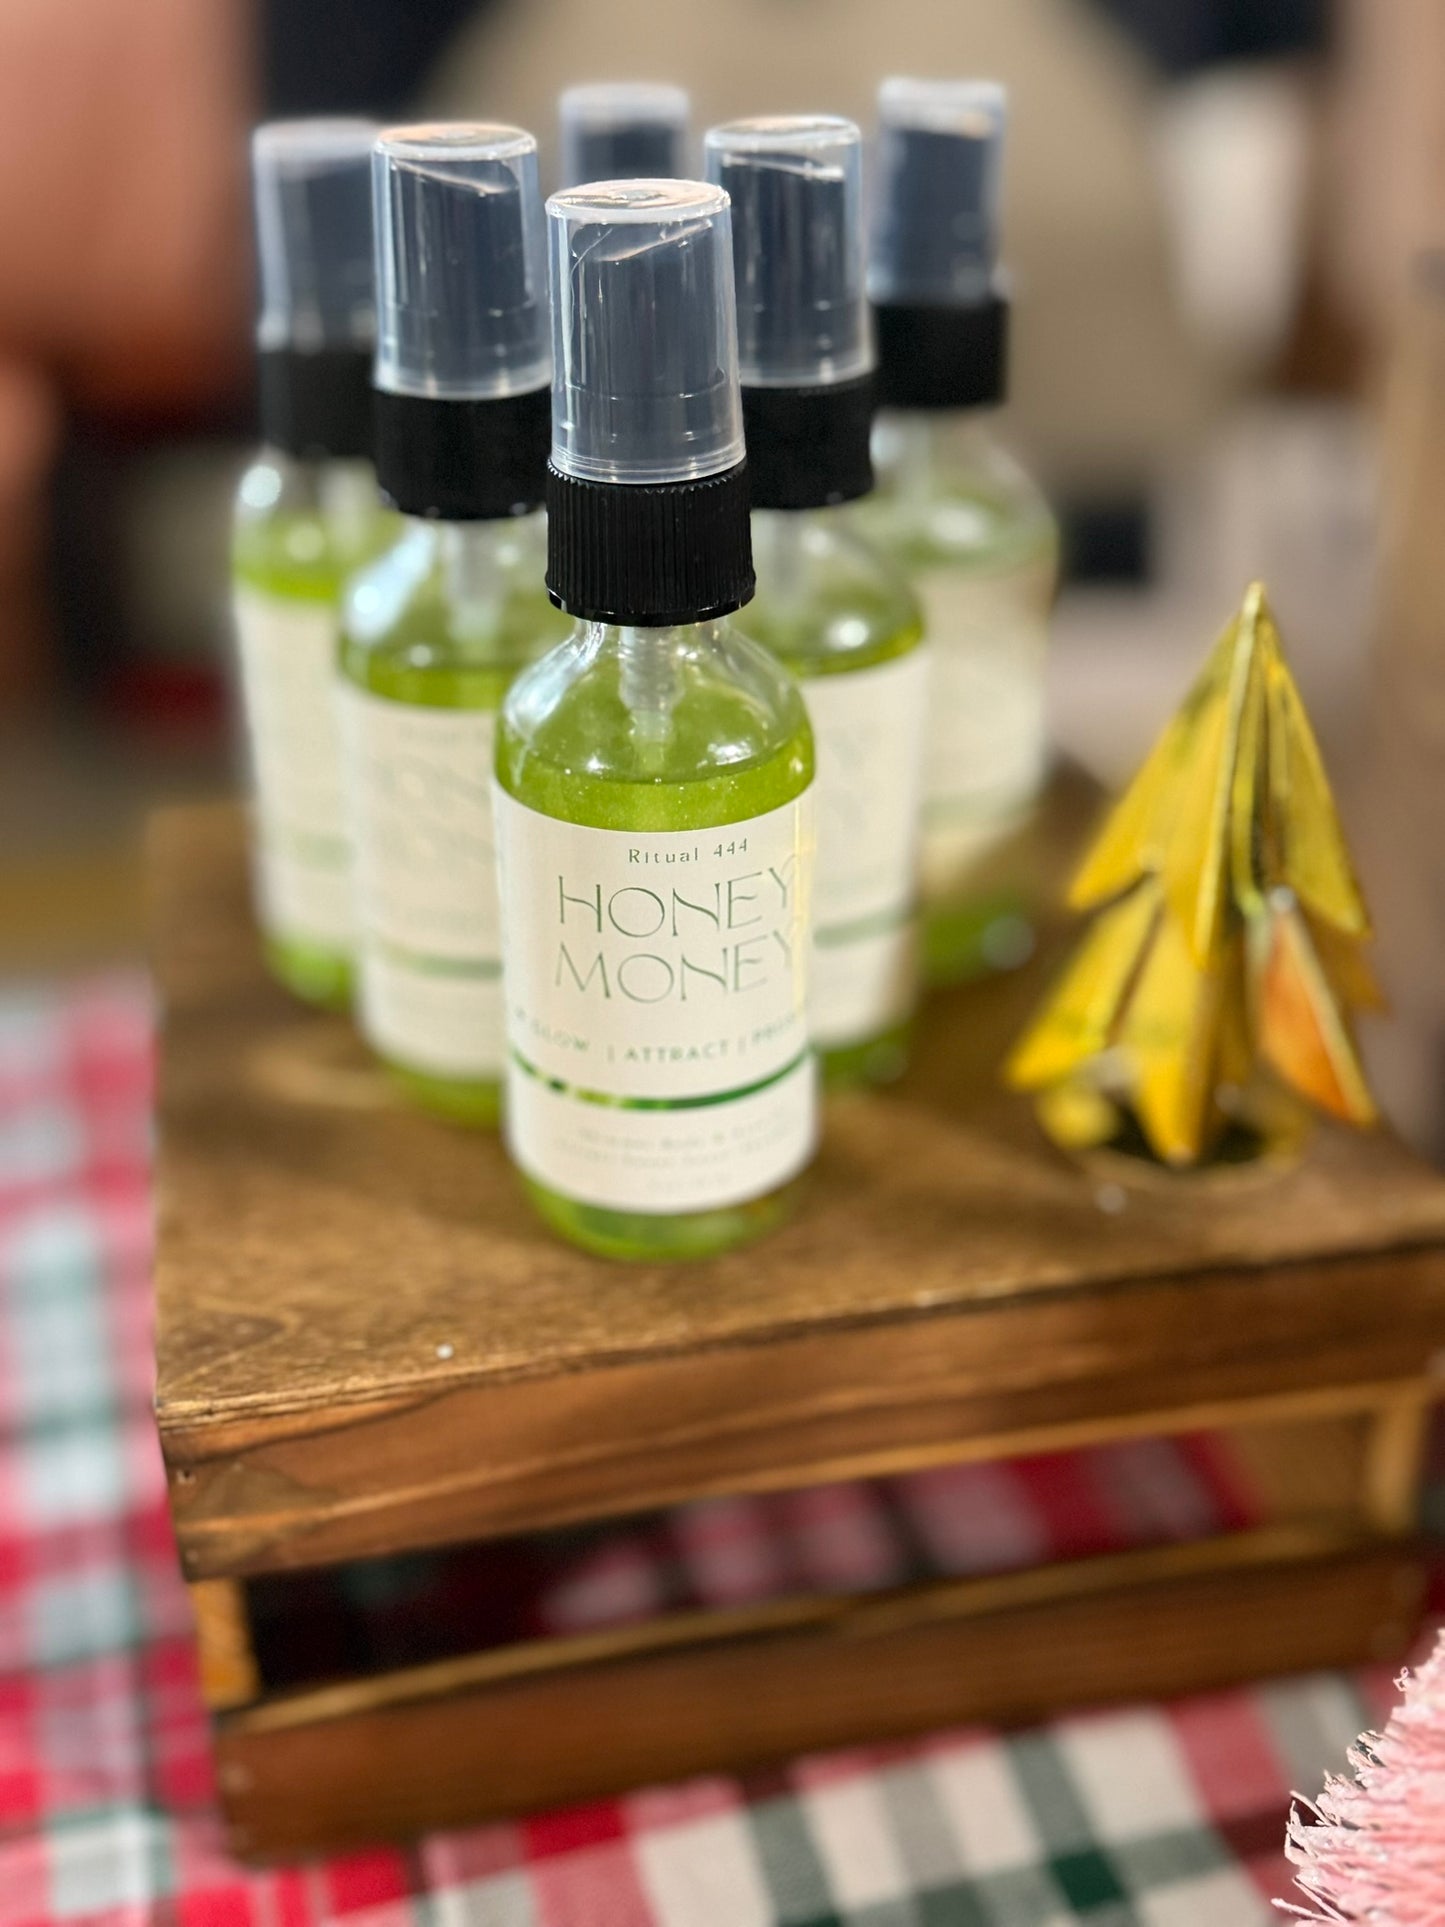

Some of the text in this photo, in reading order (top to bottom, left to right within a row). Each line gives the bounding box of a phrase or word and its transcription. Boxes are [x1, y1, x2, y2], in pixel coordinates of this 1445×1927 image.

[628, 838, 748, 863] Ritual 444
[558, 855, 797, 938] HONEY
[555, 929, 796, 1003] MONEY
[624, 1038, 728, 1062] ATTRACT
